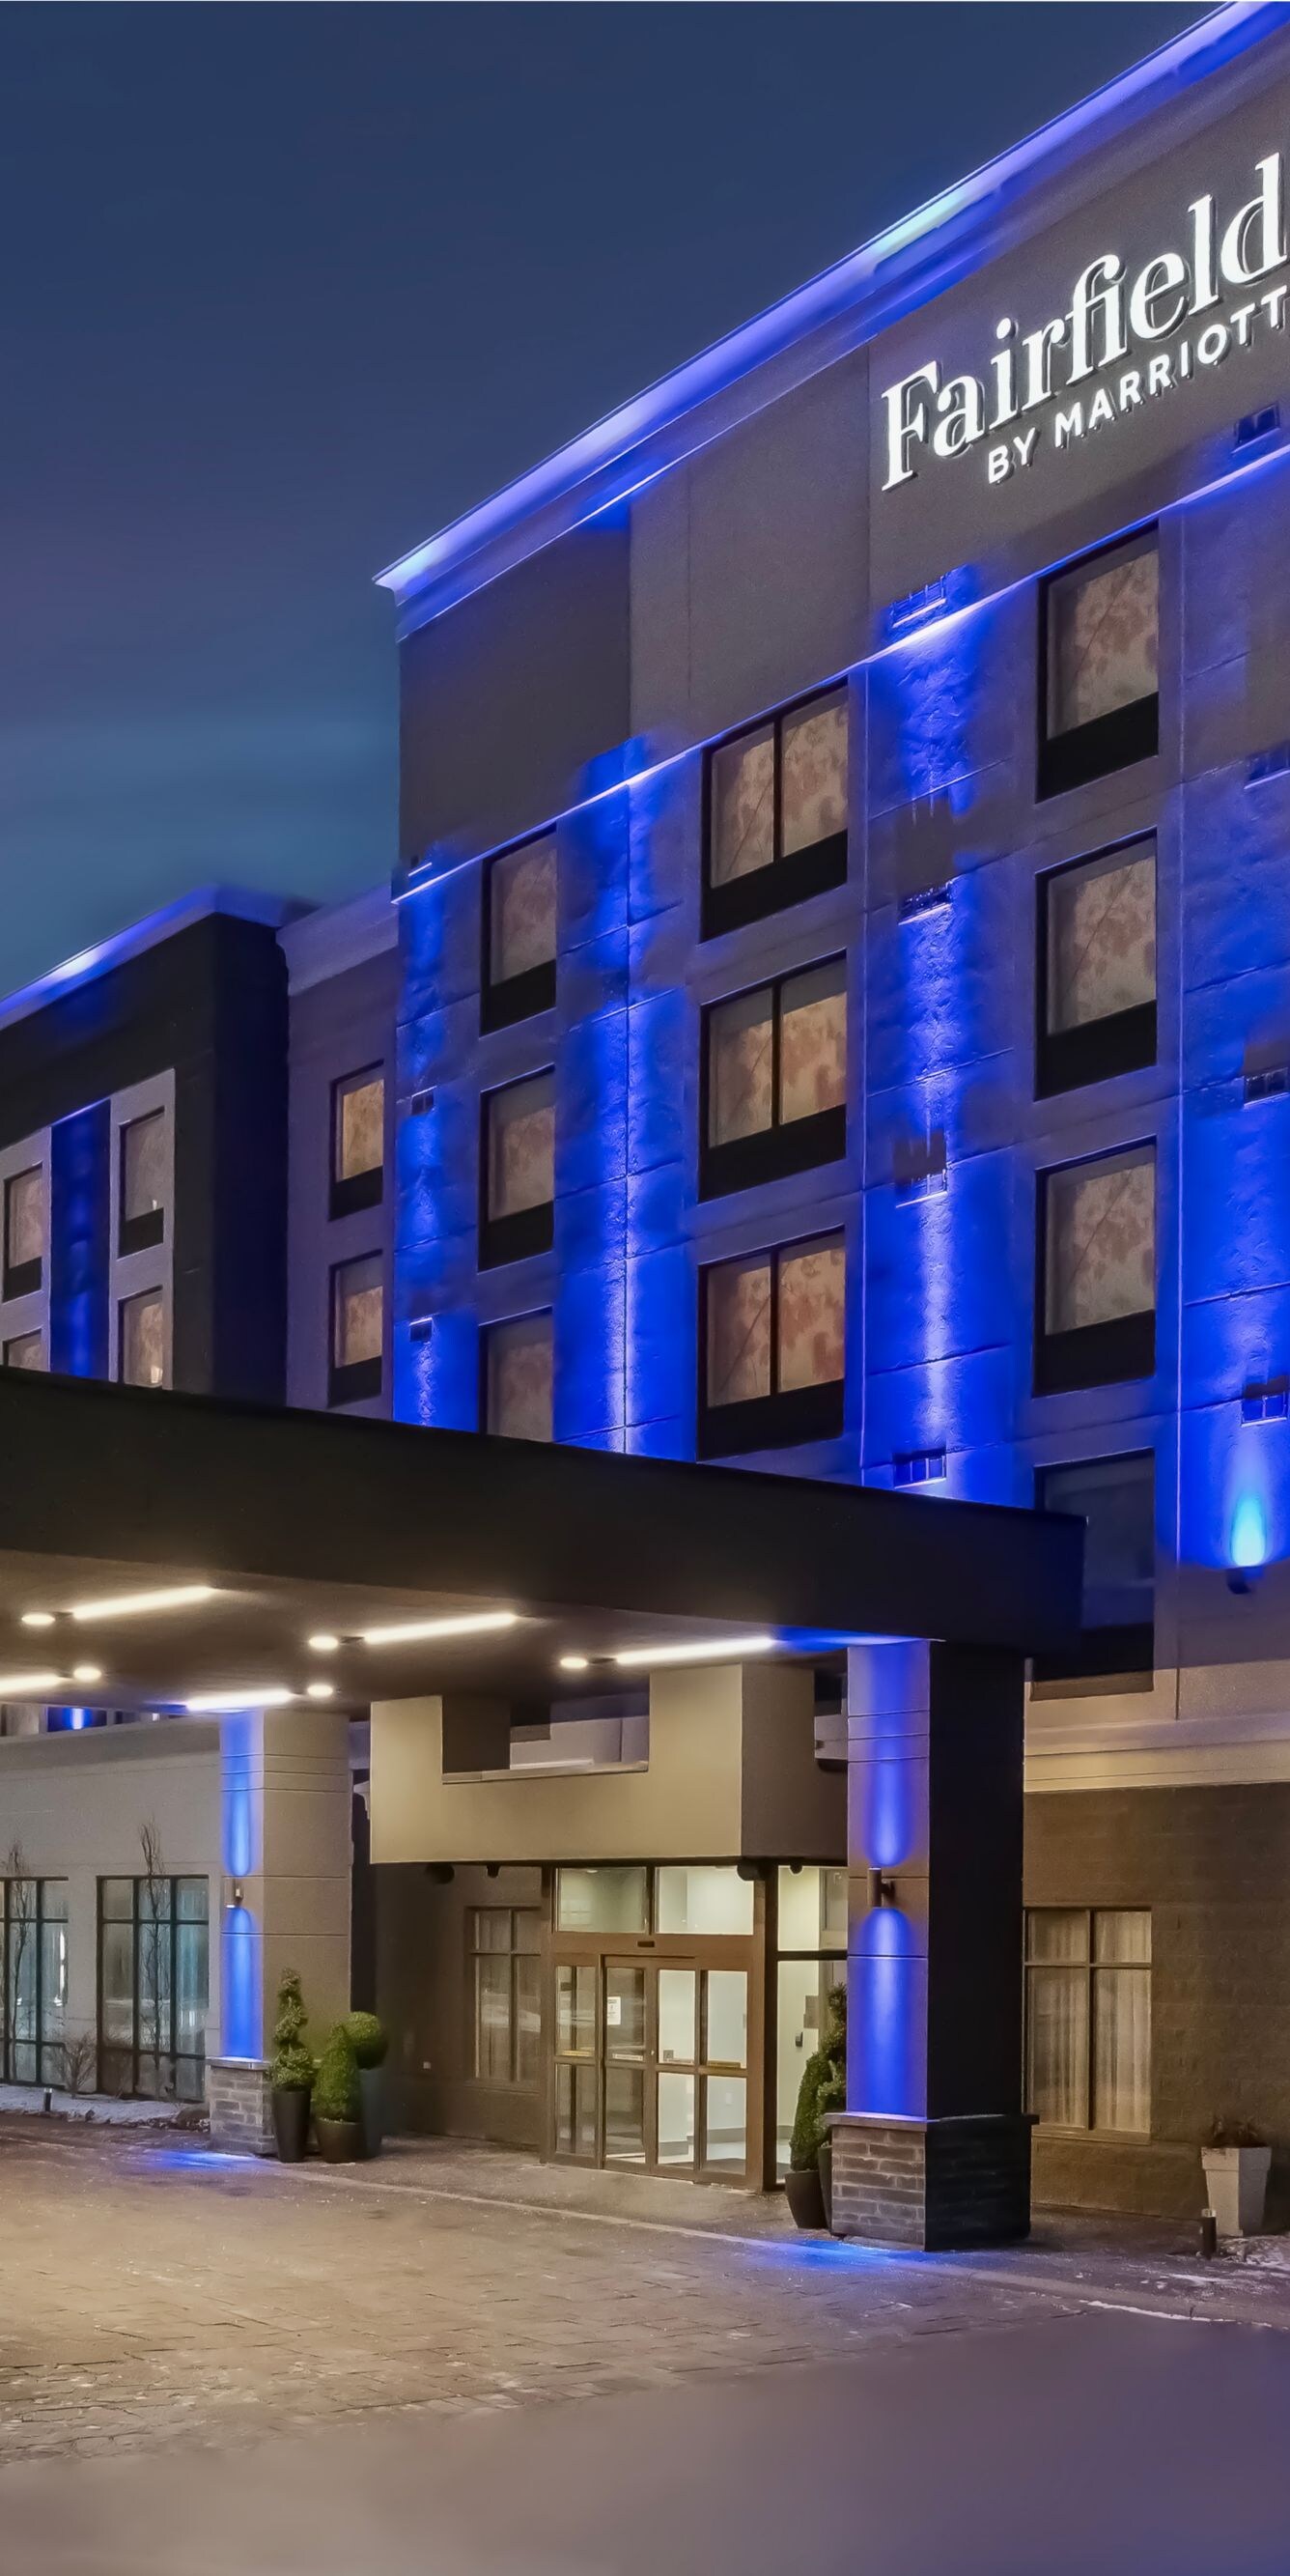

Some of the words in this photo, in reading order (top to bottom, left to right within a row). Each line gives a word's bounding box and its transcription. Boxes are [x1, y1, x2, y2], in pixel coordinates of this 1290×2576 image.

[881, 152, 1288, 492] Fairfield
[988, 427, 1039, 484] BY
[1054, 285, 1288, 449] MARRIOTT
